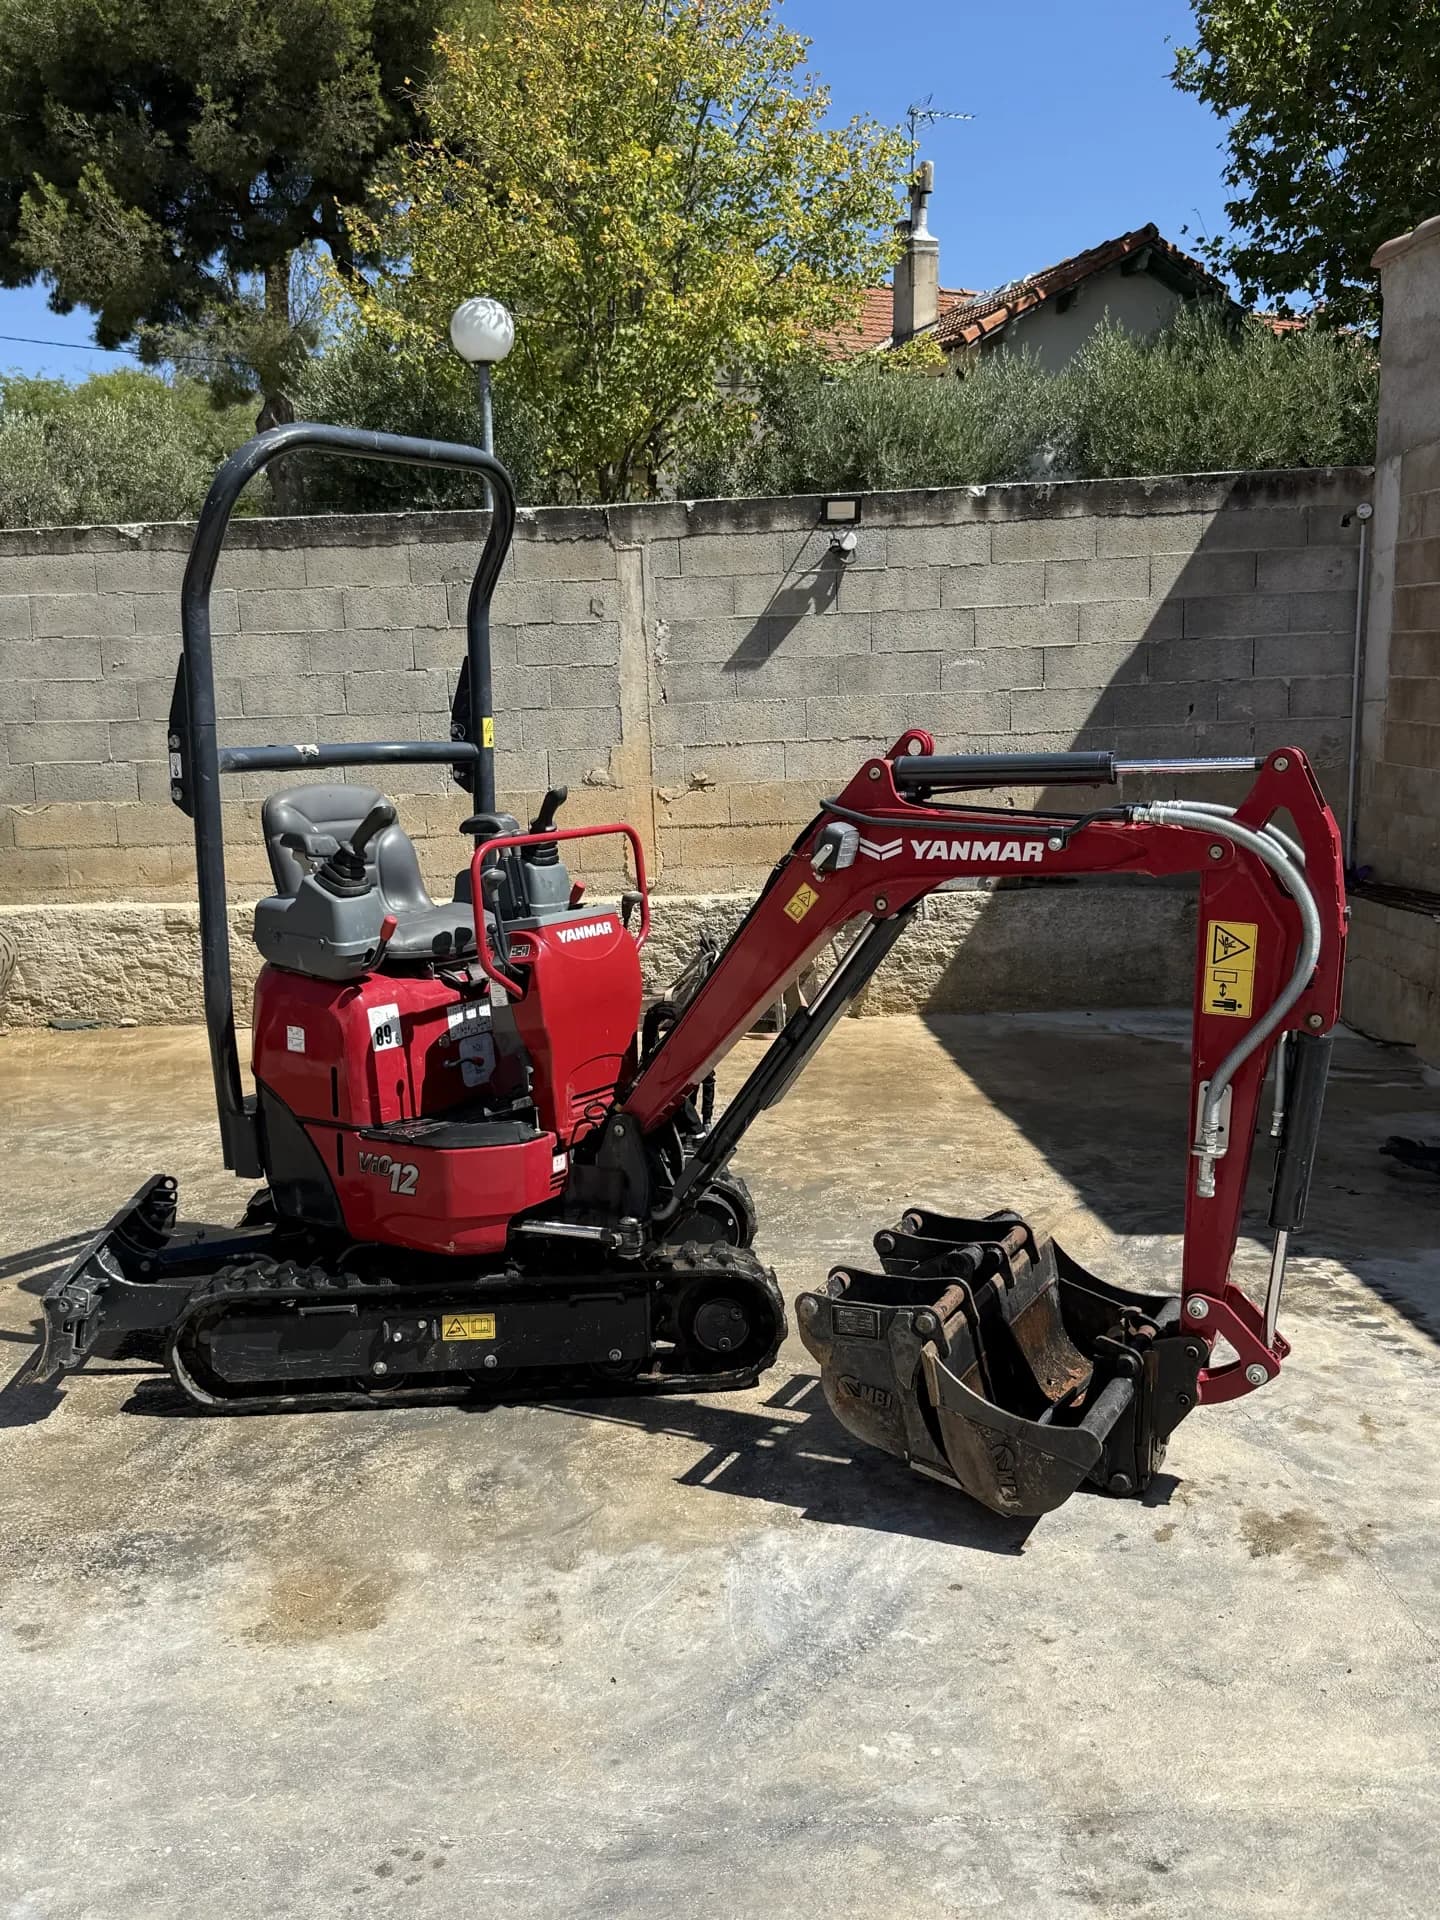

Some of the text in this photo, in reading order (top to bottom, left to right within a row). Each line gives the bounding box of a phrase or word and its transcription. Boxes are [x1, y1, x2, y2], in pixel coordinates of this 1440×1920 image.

[910, 839, 1045, 862] YANMAR
[556, 921, 613, 943] YANMAR
[375, 1024, 392, 1046] 89
